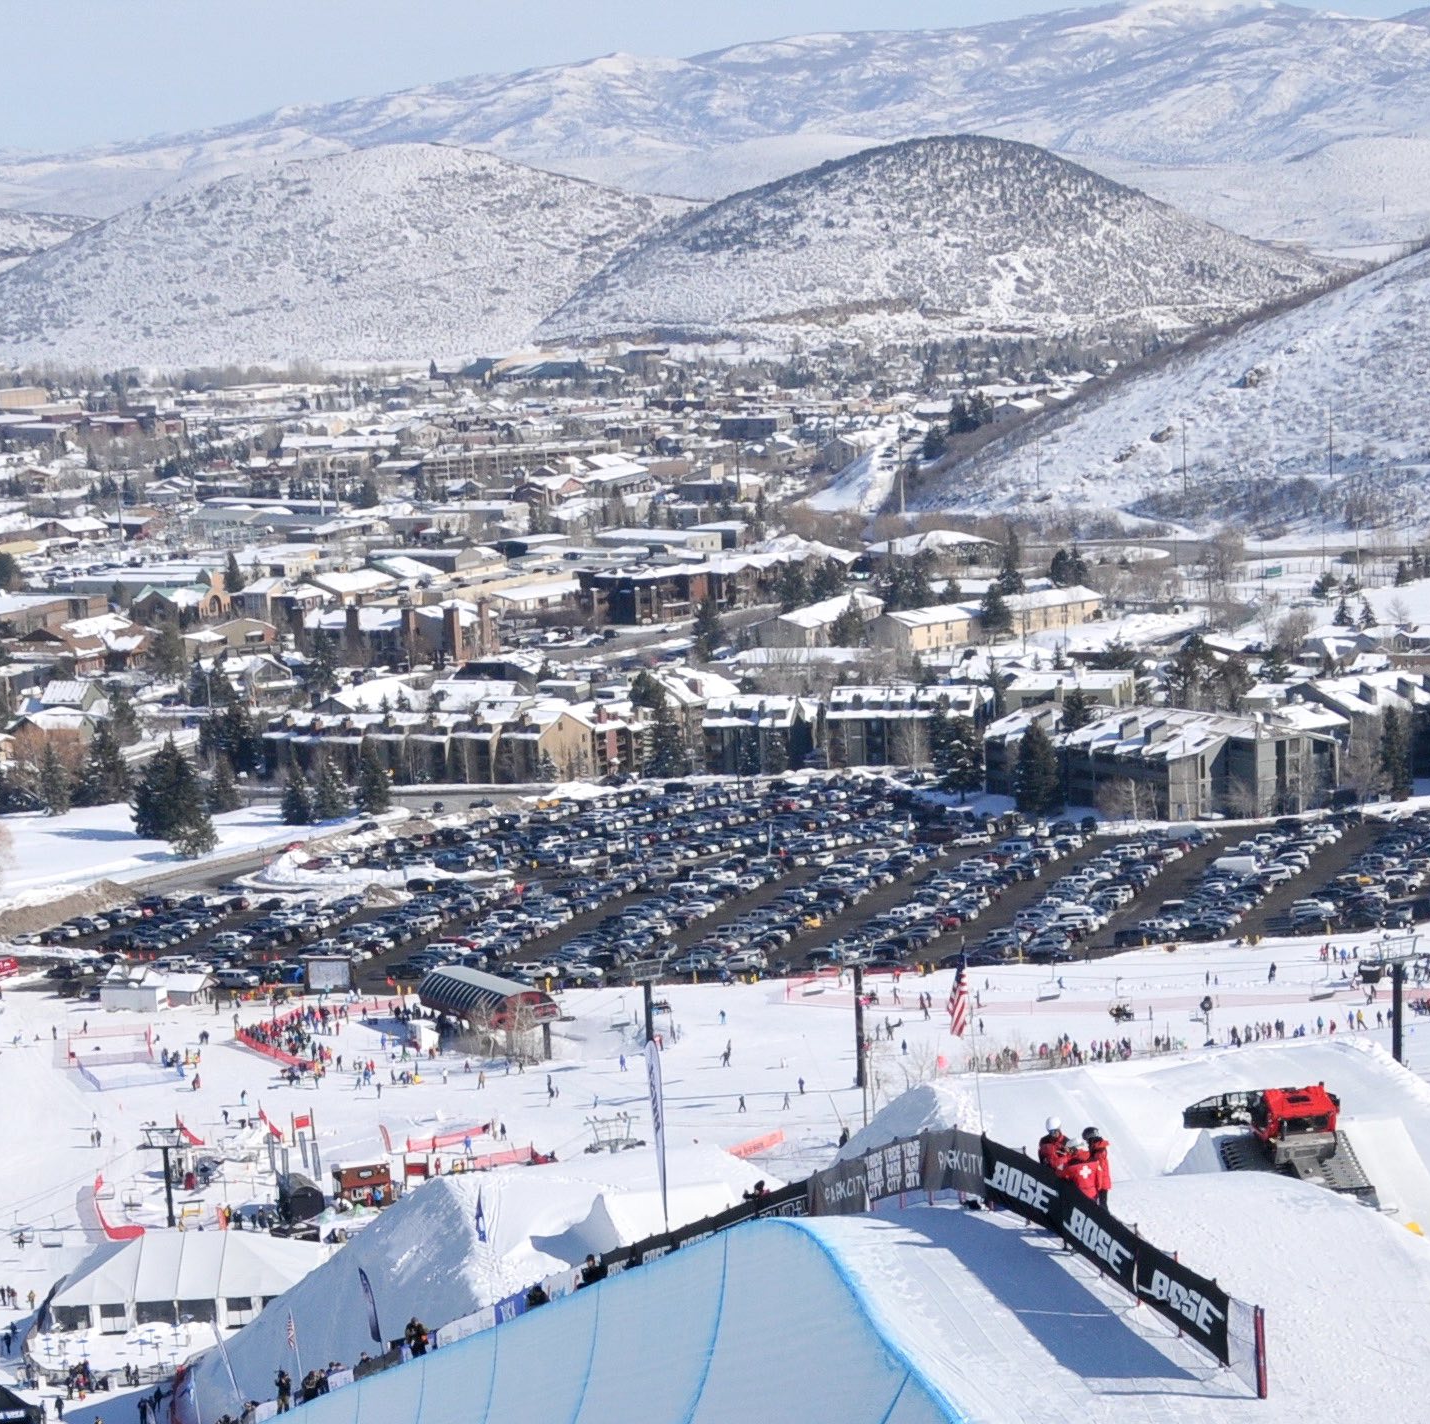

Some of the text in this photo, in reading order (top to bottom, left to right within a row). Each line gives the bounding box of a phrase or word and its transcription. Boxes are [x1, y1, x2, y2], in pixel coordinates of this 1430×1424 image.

[962, 1154, 983, 1177] CITY
[984, 1161, 1060, 1214] BOSE
[1063, 1207, 1134, 1275] BOSE
[1138, 1269, 1226, 1335] BOSE
